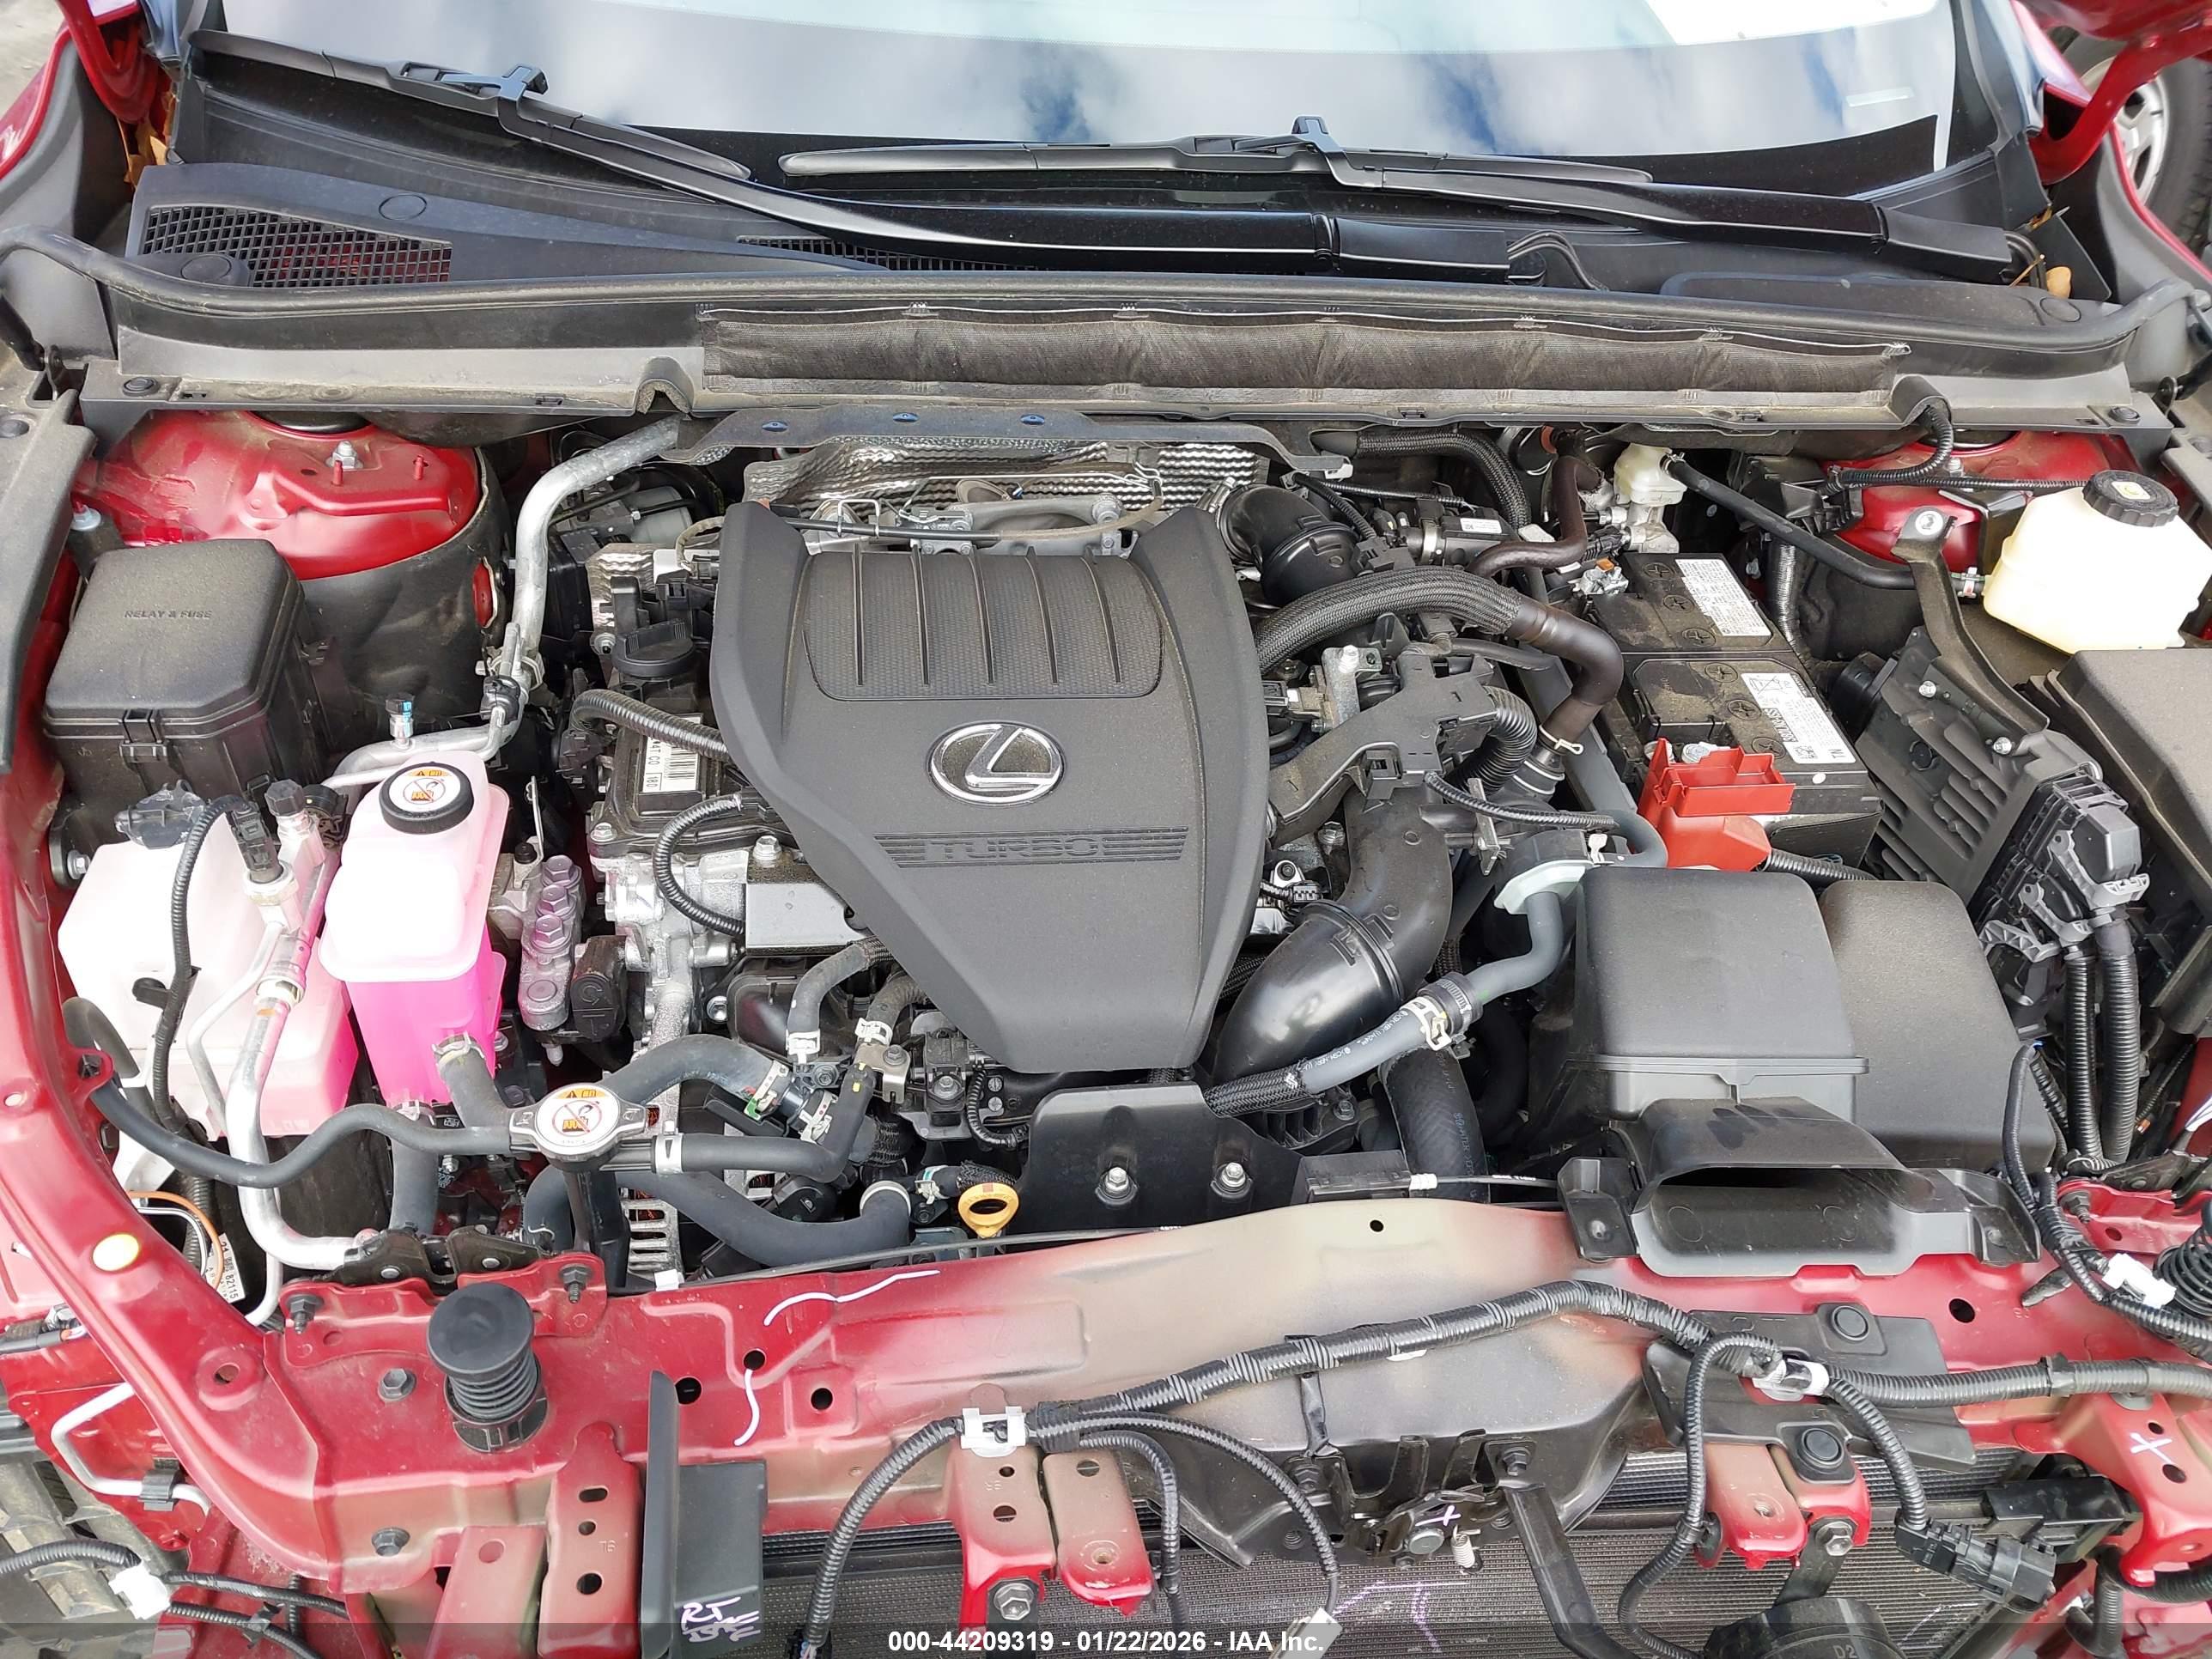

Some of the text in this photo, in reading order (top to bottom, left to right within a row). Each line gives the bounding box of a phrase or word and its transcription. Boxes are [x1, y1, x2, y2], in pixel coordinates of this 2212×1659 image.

[124, 610, 165, 619] RELAY
[179, 610, 212, 619] FUSE
[930, 837, 1099, 860] TURBO
[225, 1273, 240, 1299] 82115
